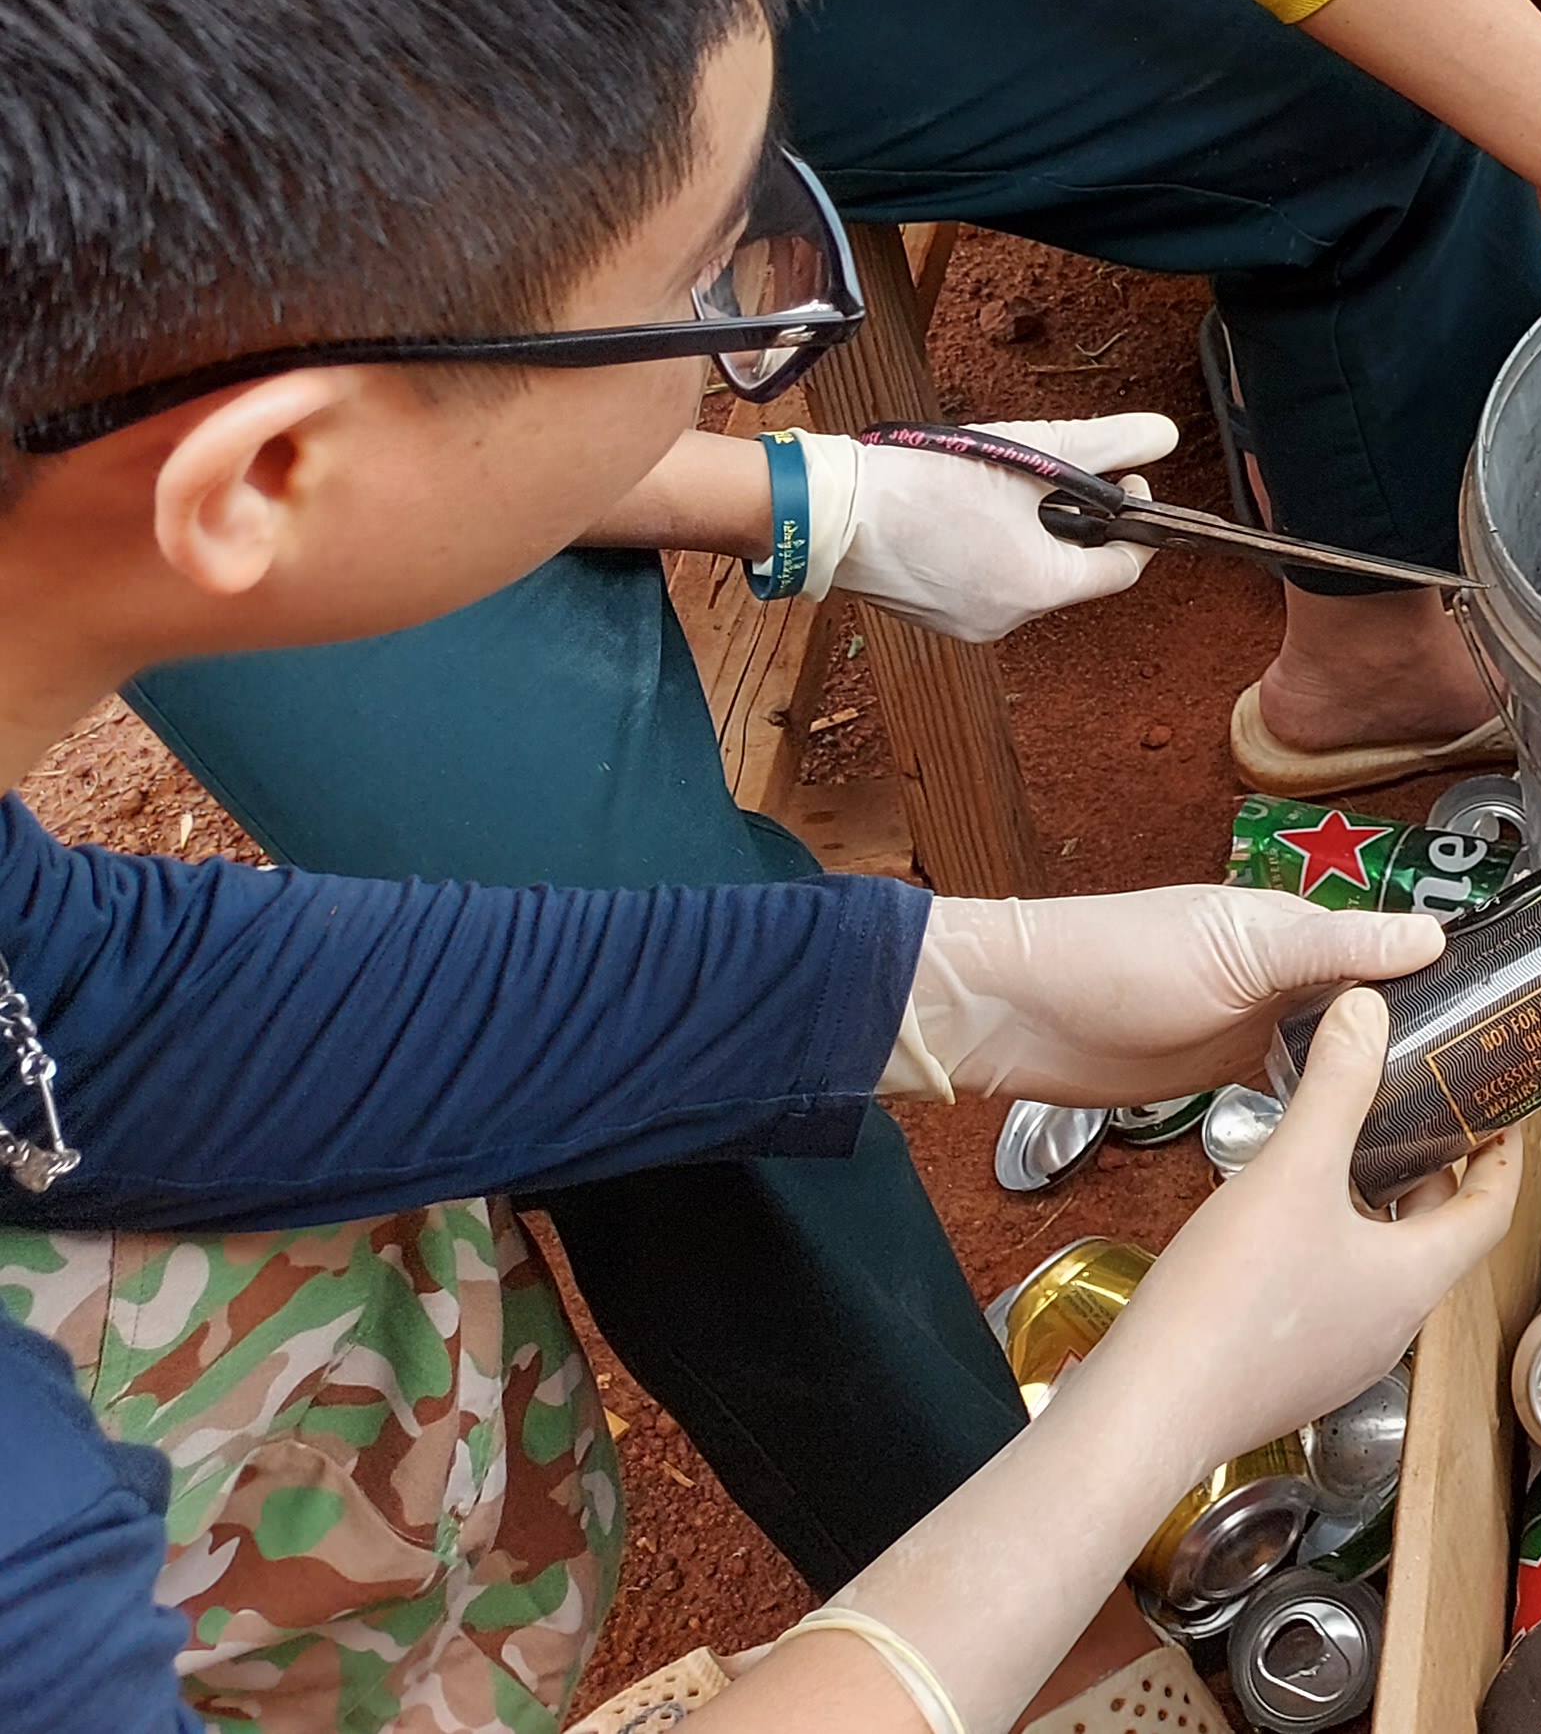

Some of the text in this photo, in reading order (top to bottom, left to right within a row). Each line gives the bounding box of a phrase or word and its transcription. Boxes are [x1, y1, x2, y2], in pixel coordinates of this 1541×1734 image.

[1477, 1023, 1513, 1055] NOT
[1508, 1006, 1541, 1036] FOR
[1482, 1077, 1541, 1120] IMPAIRS
